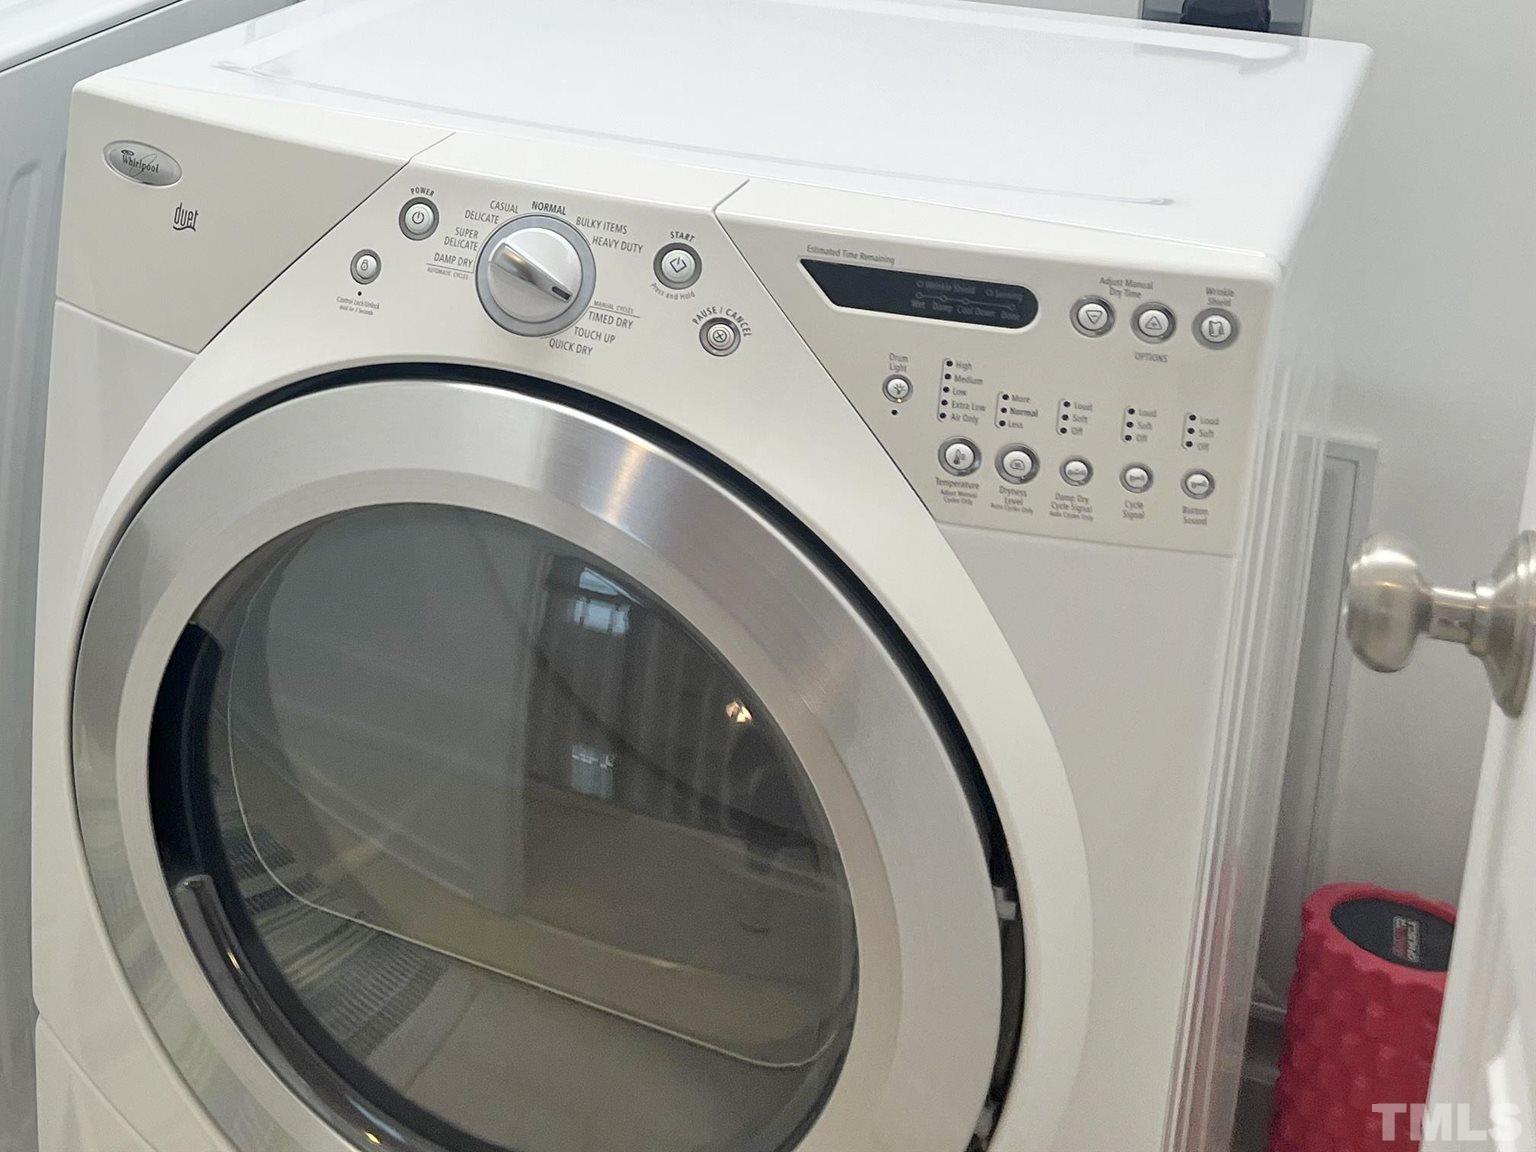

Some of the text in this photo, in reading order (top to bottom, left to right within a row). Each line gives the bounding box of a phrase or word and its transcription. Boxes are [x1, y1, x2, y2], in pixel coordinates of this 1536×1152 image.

[122, 155, 160, 174] Whirlpool
[410, 186, 434, 196] POWER
[490, 200, 519, 214] CASUAL
[531, 200, 566, 216] NORMAL
[174, 202, 198, 228] duet
[464, 210, 499, 224] DELICATE
[576, 216, 628, 234] BULKY ITEMS
[455, 227, 478, 239] SUPER
[670, 230, 696, 243] START
[444, 238, 478, 251] DELICATE
[592, 236, 643, 254] HEAVY DUTY
[434, 252, 474, 268] DAMP DRY
[806, 244, 895, 265] Estimated Time Remaining
[1100, 277, 1154, 290] Adjust Manual
[650, 282, 664, 298] Press
[680, 291, 696, 300] Hold
[1110, 288, 1142, 298] Dry Time
[594, 300, 614, 312] MANUAL
[589, 311, 634, 329] TIMED DRY
[692, 306, 717, 325] PAUSE
[726, 308, 752, 337] CANCEL
[574, 326, 616, 344] TOUCH UP
[549, 338, 593, 356] QUICK DRY
[890, 353, 908, 362] Drum
[1135, 352, 1168, 362] OPTIONS
[890, 363, 907, 372] Light
[956, 361, 972, 372] High
[954, 375, 984, 385] Medium
[952, 388, 967, 396] Low
[1012, 394, 1030, 402] More
[952, 402, 986, 412] Extra Low
[1010, 406, 1038, 417] Normal
[1074, 402, 1093, 411] Loud
[1072, 414, 1088, 424] Soft
[1139, 409, 1157, 418] Loud
[962, 415, 980, 425] Only
[1008, 420, 1024, 428] Less
[1071, 427, 1084, 436] Off
[1138, 422, 1152, 430] Soft
[1136, 434, 1148, 442] Off
[936, 477, 980, 490] Temperature
[999, 486, 1028, 498] Dryness
[1004, 497, 1024, 506] Level
[1124, 500, 1144, 510] Cycle
[1050, 502, 1093, 514] Cycle Signal
[1122, 510, 1146, 520] Signal
[1184, 516, 1208, 526] Sound
